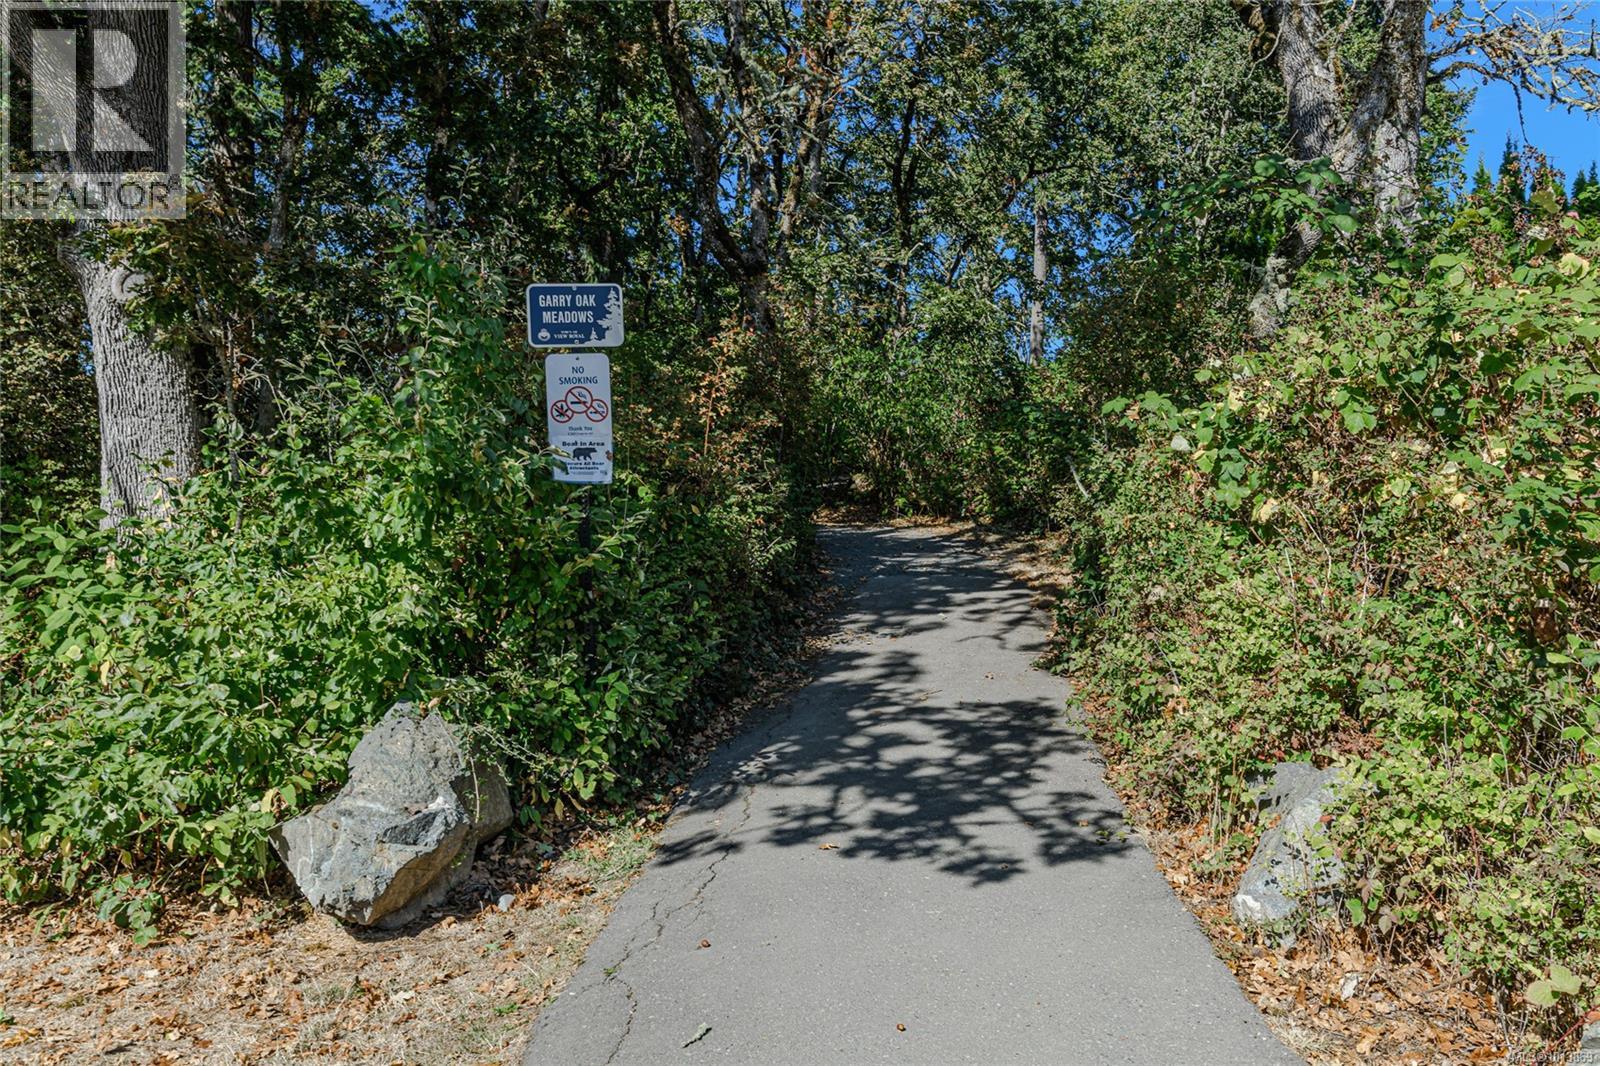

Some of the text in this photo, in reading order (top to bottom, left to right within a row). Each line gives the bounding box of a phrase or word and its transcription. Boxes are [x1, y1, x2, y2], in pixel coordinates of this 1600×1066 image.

[538, 294, 597, 307] GARRY OAK
[542, 310, 594, 324] MEADOWS
[571, 366, 585, 374] NO
[558, 376, 598, 385] SMOKING
